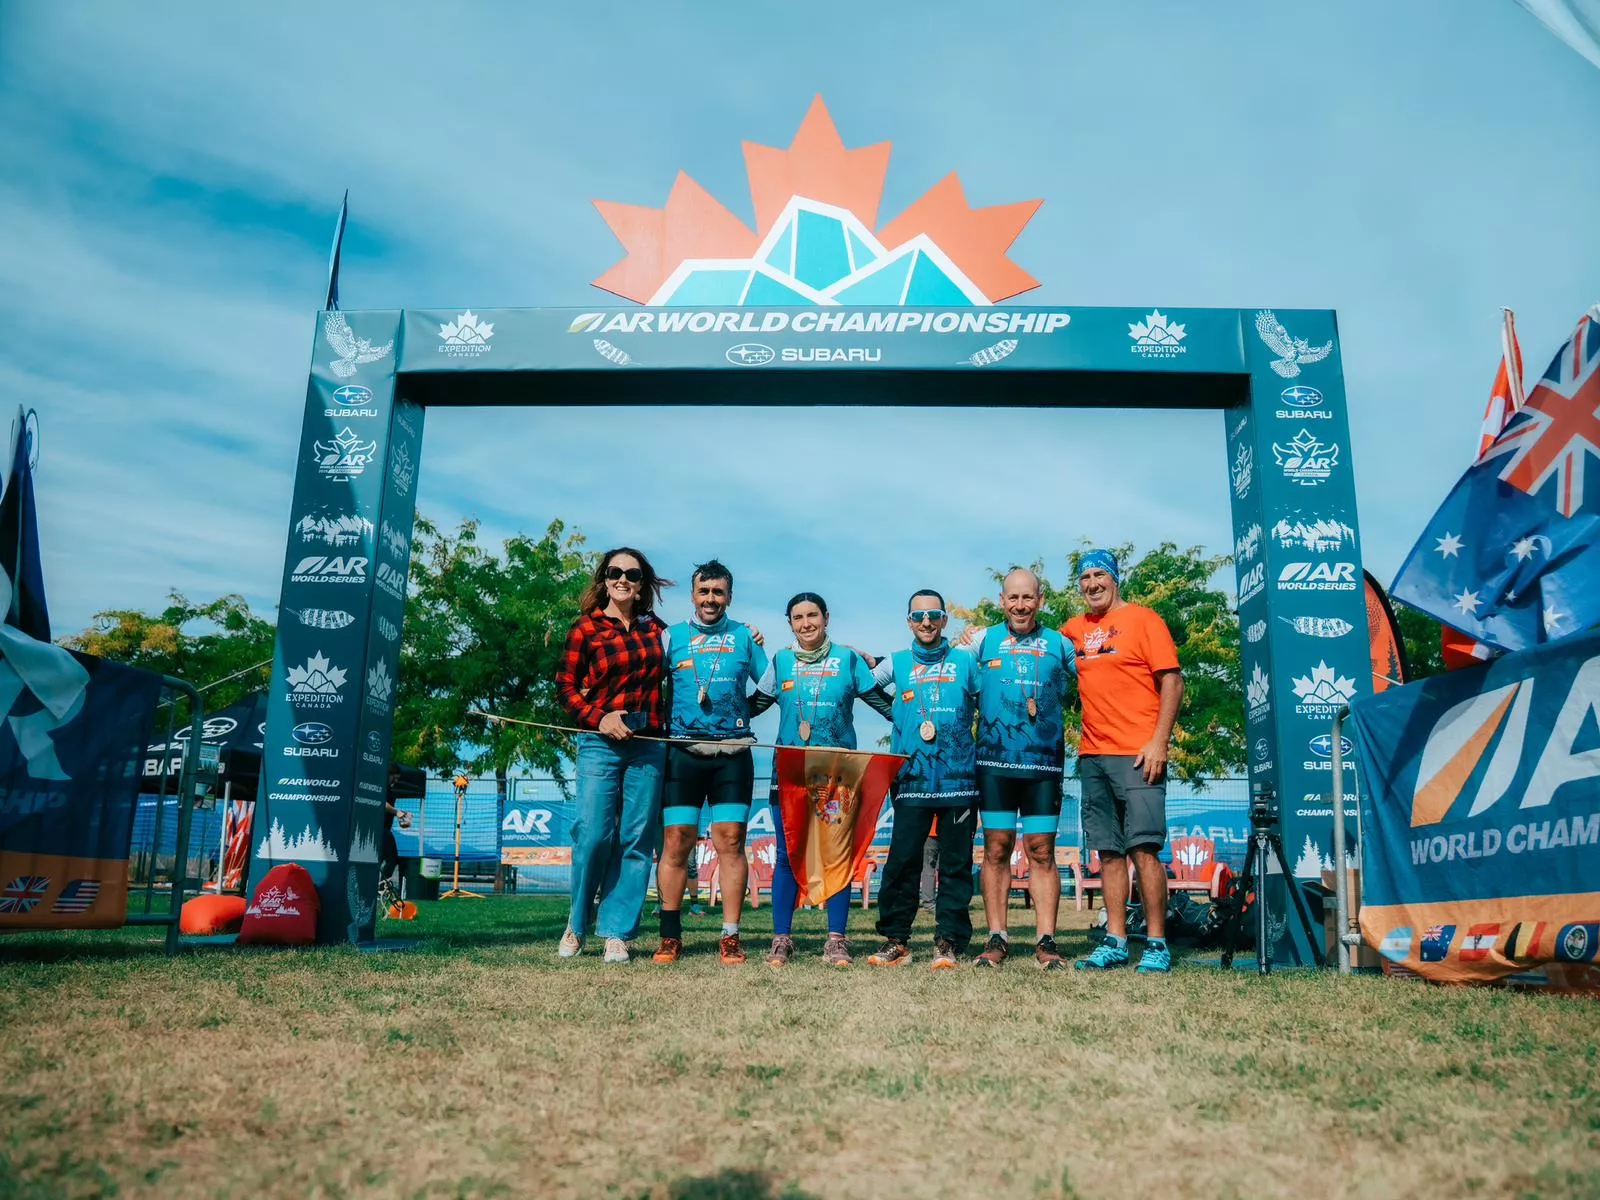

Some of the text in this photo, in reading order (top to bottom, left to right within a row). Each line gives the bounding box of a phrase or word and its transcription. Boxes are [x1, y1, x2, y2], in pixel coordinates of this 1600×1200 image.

[658, 312, 787, 333] WORLD
[791, 311, 1071, 334] CHAMPIONSHIP
[438, 345, 492, 354] EXPEDITION
[1130, 345, 1187, 354] EXPEDITION
[781, 348, 881, 362] SUBARU
[324, 408, 378, 418] SUBARU
[1275, 410, 1332, 419] SUBARU
[336, 454, 367, 466] AR
[1300, 457, 1331, 469] AR
[319, 556, 369, 575] AR
[1306, 562, 1357, 582] AR
[290, 575, 328, 583] WORLD
[1277, 582, 1357, 590] WORLD SERIES
[926, 662, 957, 674] AR
[285, 693, 344, 703] EXPEDITION
[1295, 704, 1340, 714] EXPEDIT
[283, 747, 339, 757] SUBARU
[303, 778, 340, 788] WORLD
[269, 792, 341, 802] CHAMPIONSHIP
[502, 809, 553, 833] AR
[1409, 827, 1502, 865] WORLD
